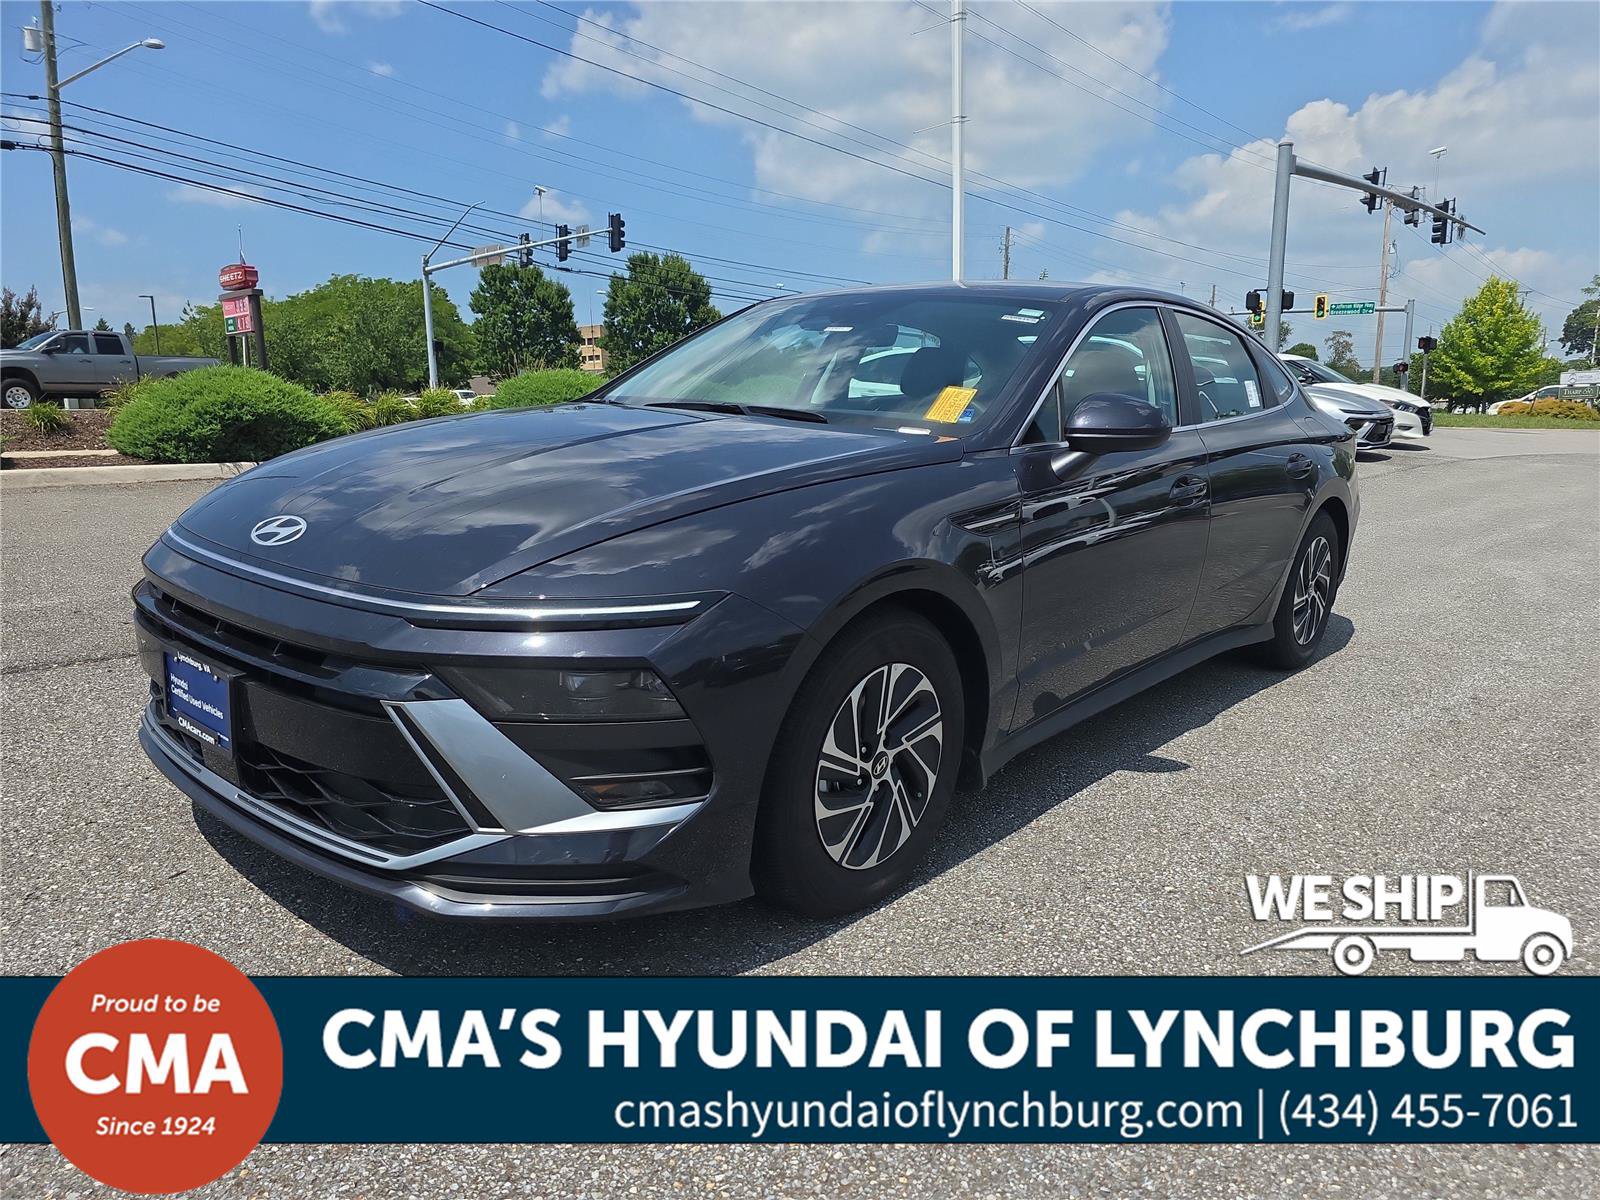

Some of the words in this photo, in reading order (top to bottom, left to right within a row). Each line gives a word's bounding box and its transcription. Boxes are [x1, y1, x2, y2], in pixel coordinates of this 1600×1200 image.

[220, 271, 242, 283] SHEETZ
[177, 651, 203, 671] Lynchburg,
[203, 663, 211, 673] VA
[170, 673, 188, 690] Hyundai
[171, 684, 189, 701] Certified
[188, 694, 202, 708] Used
[201, 700, 224, 719] Vehicles
[178, 716, 215, 744] CMAcars.com
